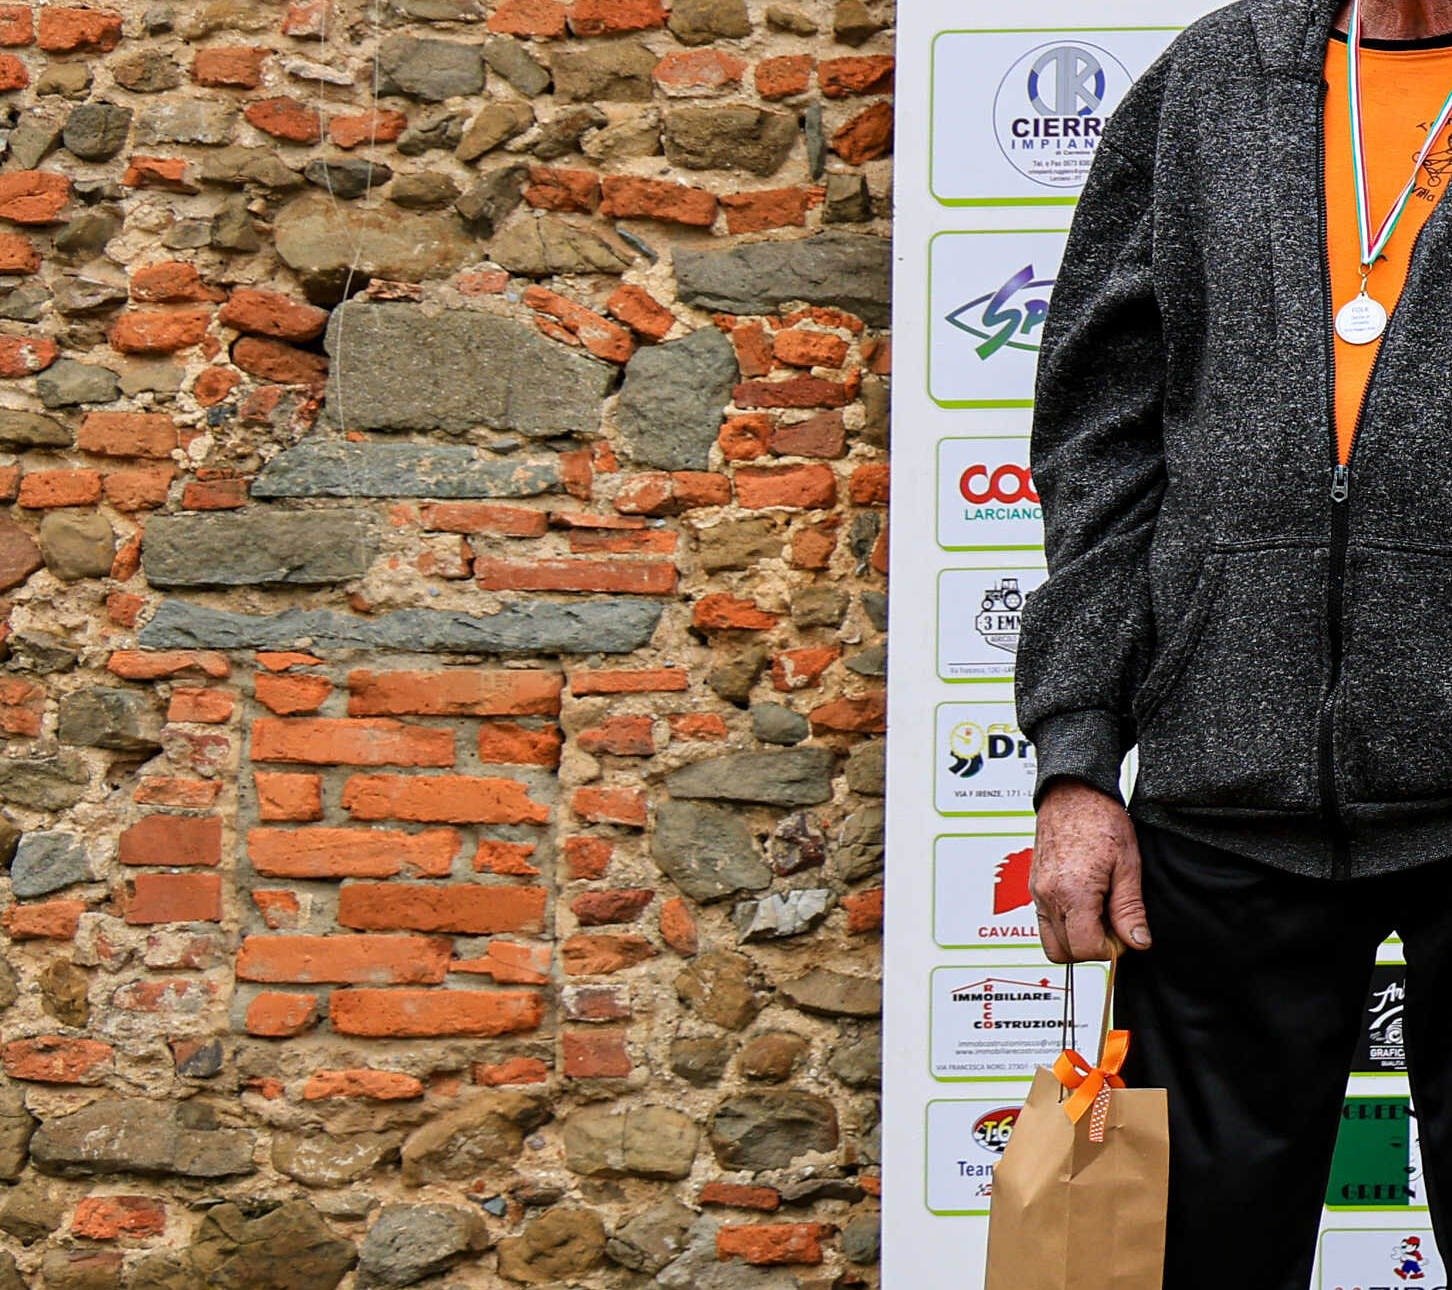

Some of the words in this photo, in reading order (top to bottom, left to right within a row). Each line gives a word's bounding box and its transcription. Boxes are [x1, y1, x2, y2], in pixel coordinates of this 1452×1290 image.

[1012, 117, 1113, 137] CIERR
[1012, 139, 1094, 150] IMPIAN
[978, 926, 1039, 938] CAVALL
[953, 993, 1052, 1002] IMMOBILIARE
